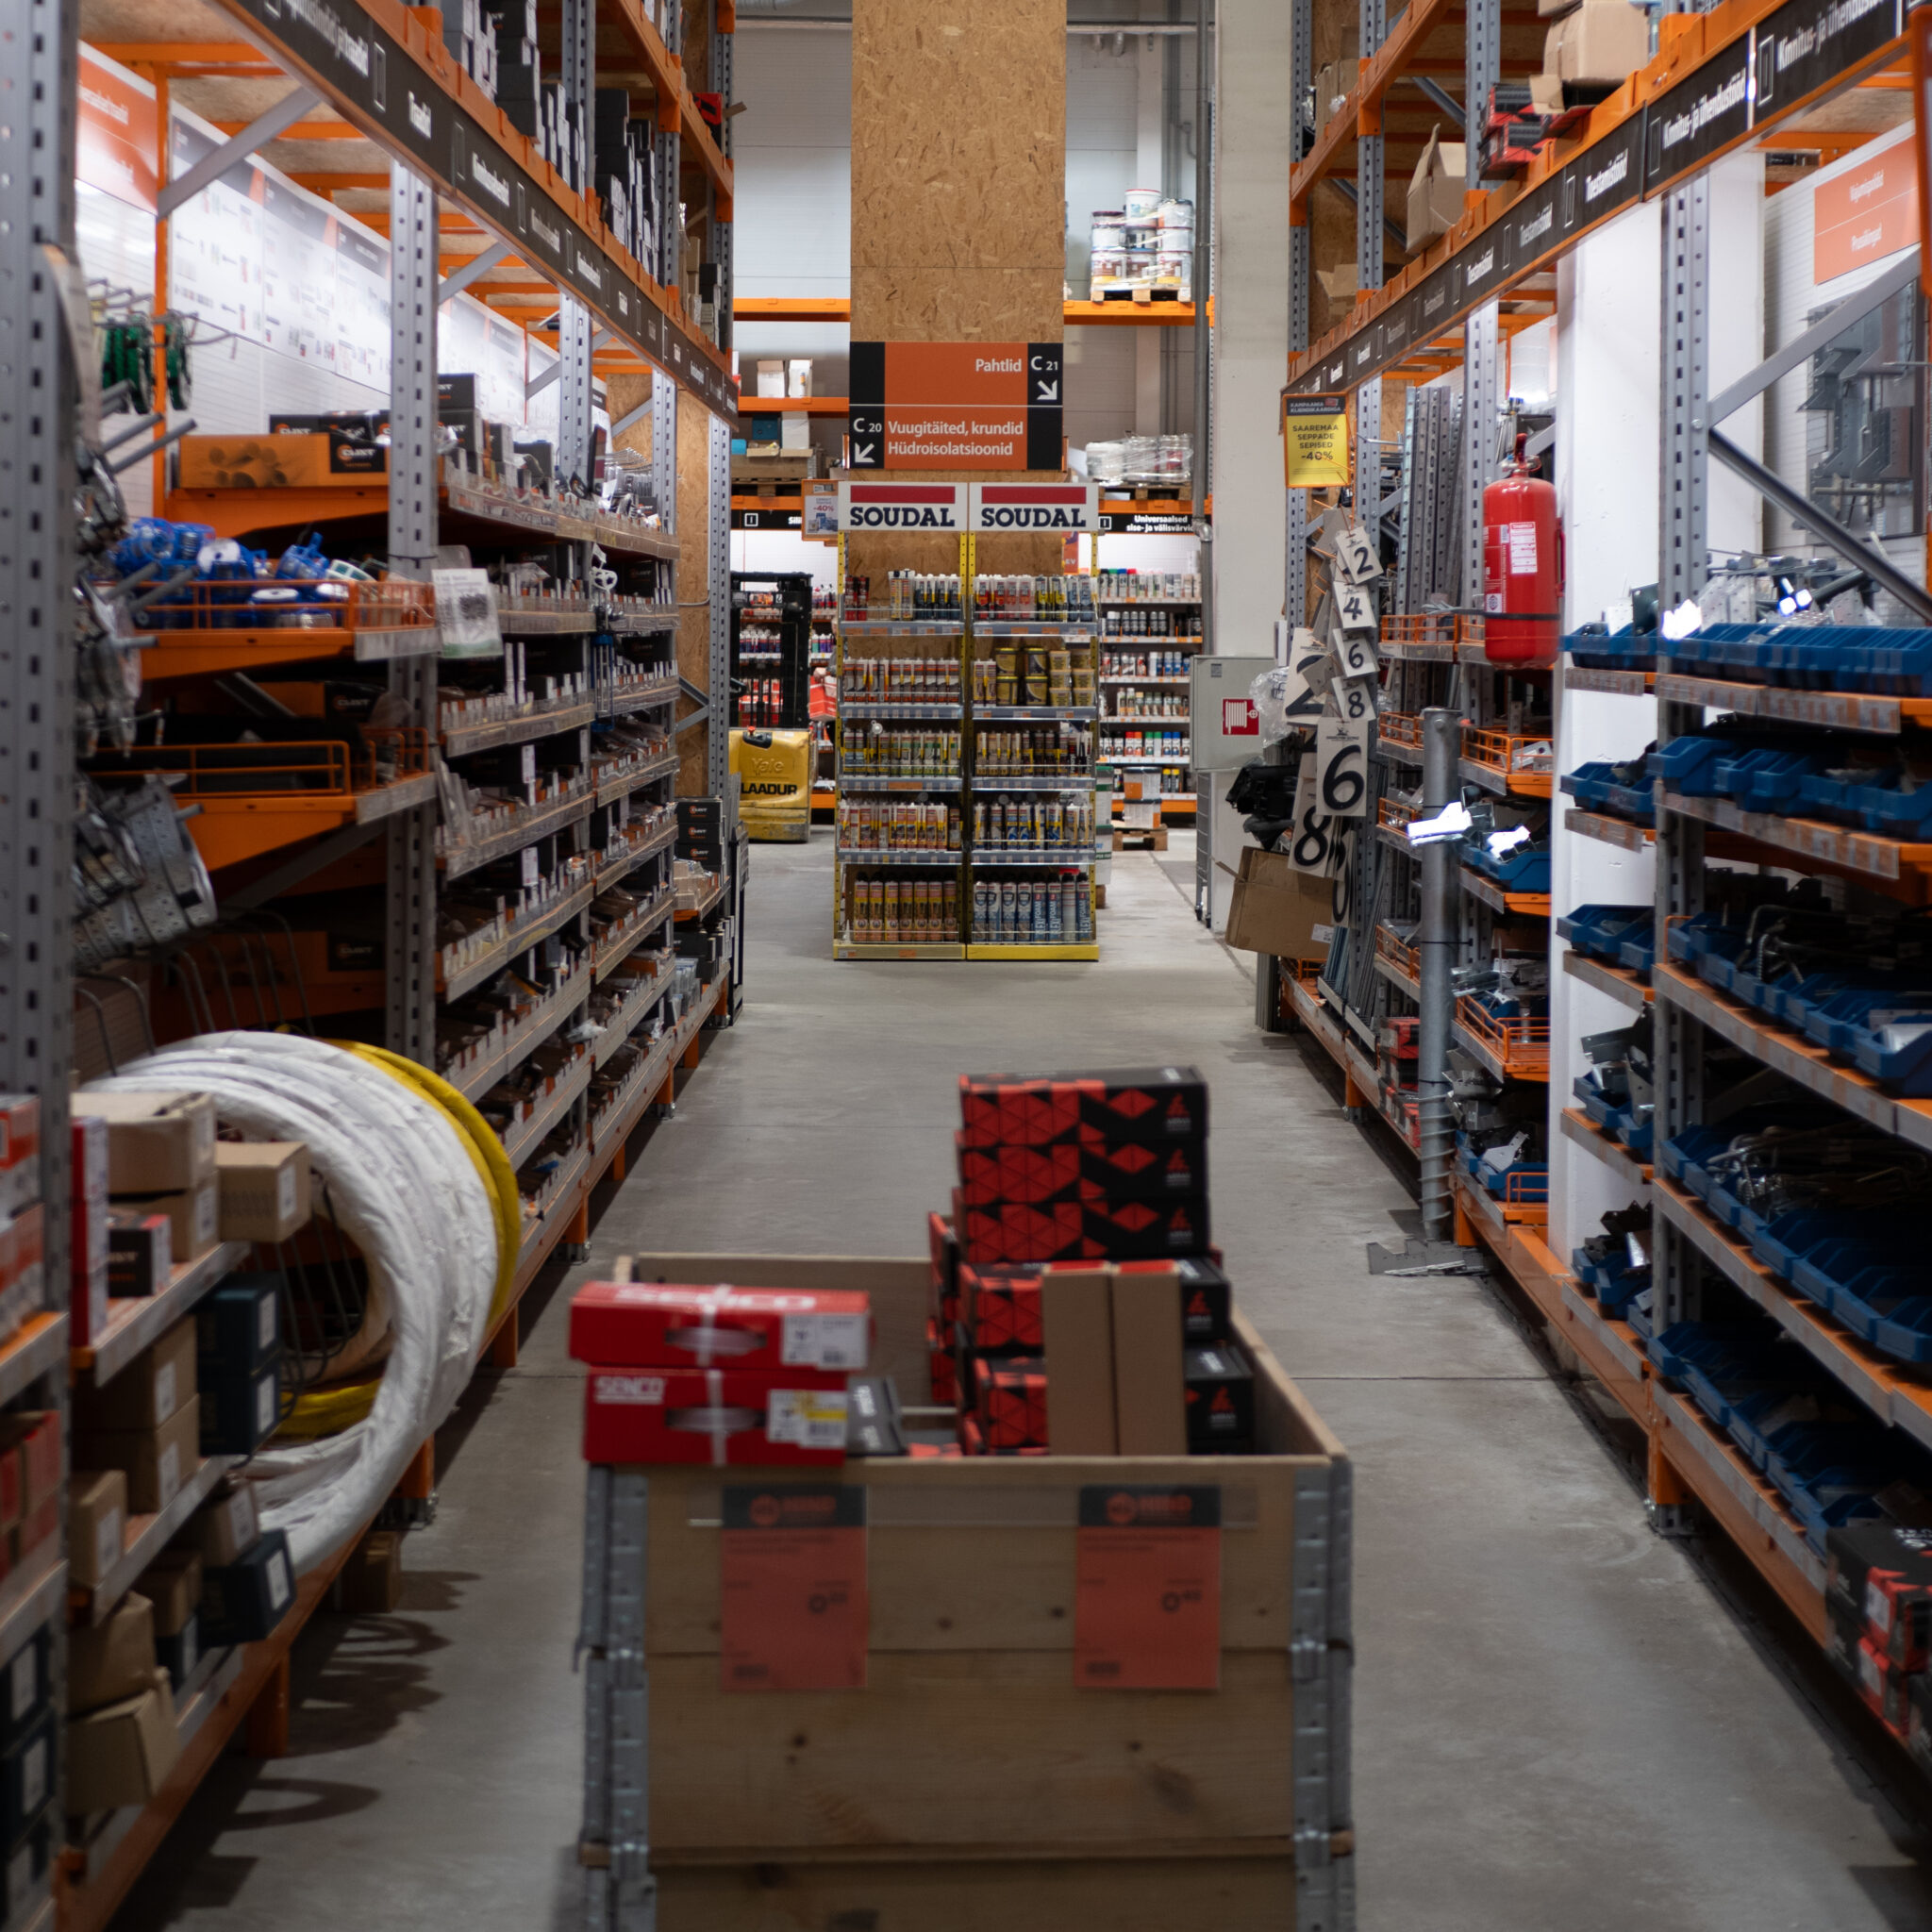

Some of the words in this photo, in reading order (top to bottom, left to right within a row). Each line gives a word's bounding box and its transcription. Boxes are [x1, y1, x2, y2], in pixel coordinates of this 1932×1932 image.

[974, 358, 1022, 373] Pahtlid
[1030, 356, 1042, 371] C
[1045, 360, 1058, 371] 21
[853, 417, 865, 432] C
[869, 423, 882, 433] 20
[888, 421, 969, 437] Vuugitäited,
[971, 421, 1024, 435] krundid
[888, 441, 1013, 456] Hüdroisolatsioonid
[1301, 451, 1333, 460] -40%
[850, 507, 956, 526] SOUDAL
[981, 508, 1087, 527] SOUDAL
[1354, 546, 1374, 575] 2
[1342, 596, 1363, 621] 4
[1348, 642, 1364, 669] 6
[1348, 691, 1365, 718] 8
[752, 758, 784, 773] Yale
[1323, 744, 1365, 810] 6
[741, 783, 798, 795] LAADUR
[1294, 804, 1332, 866] 8
